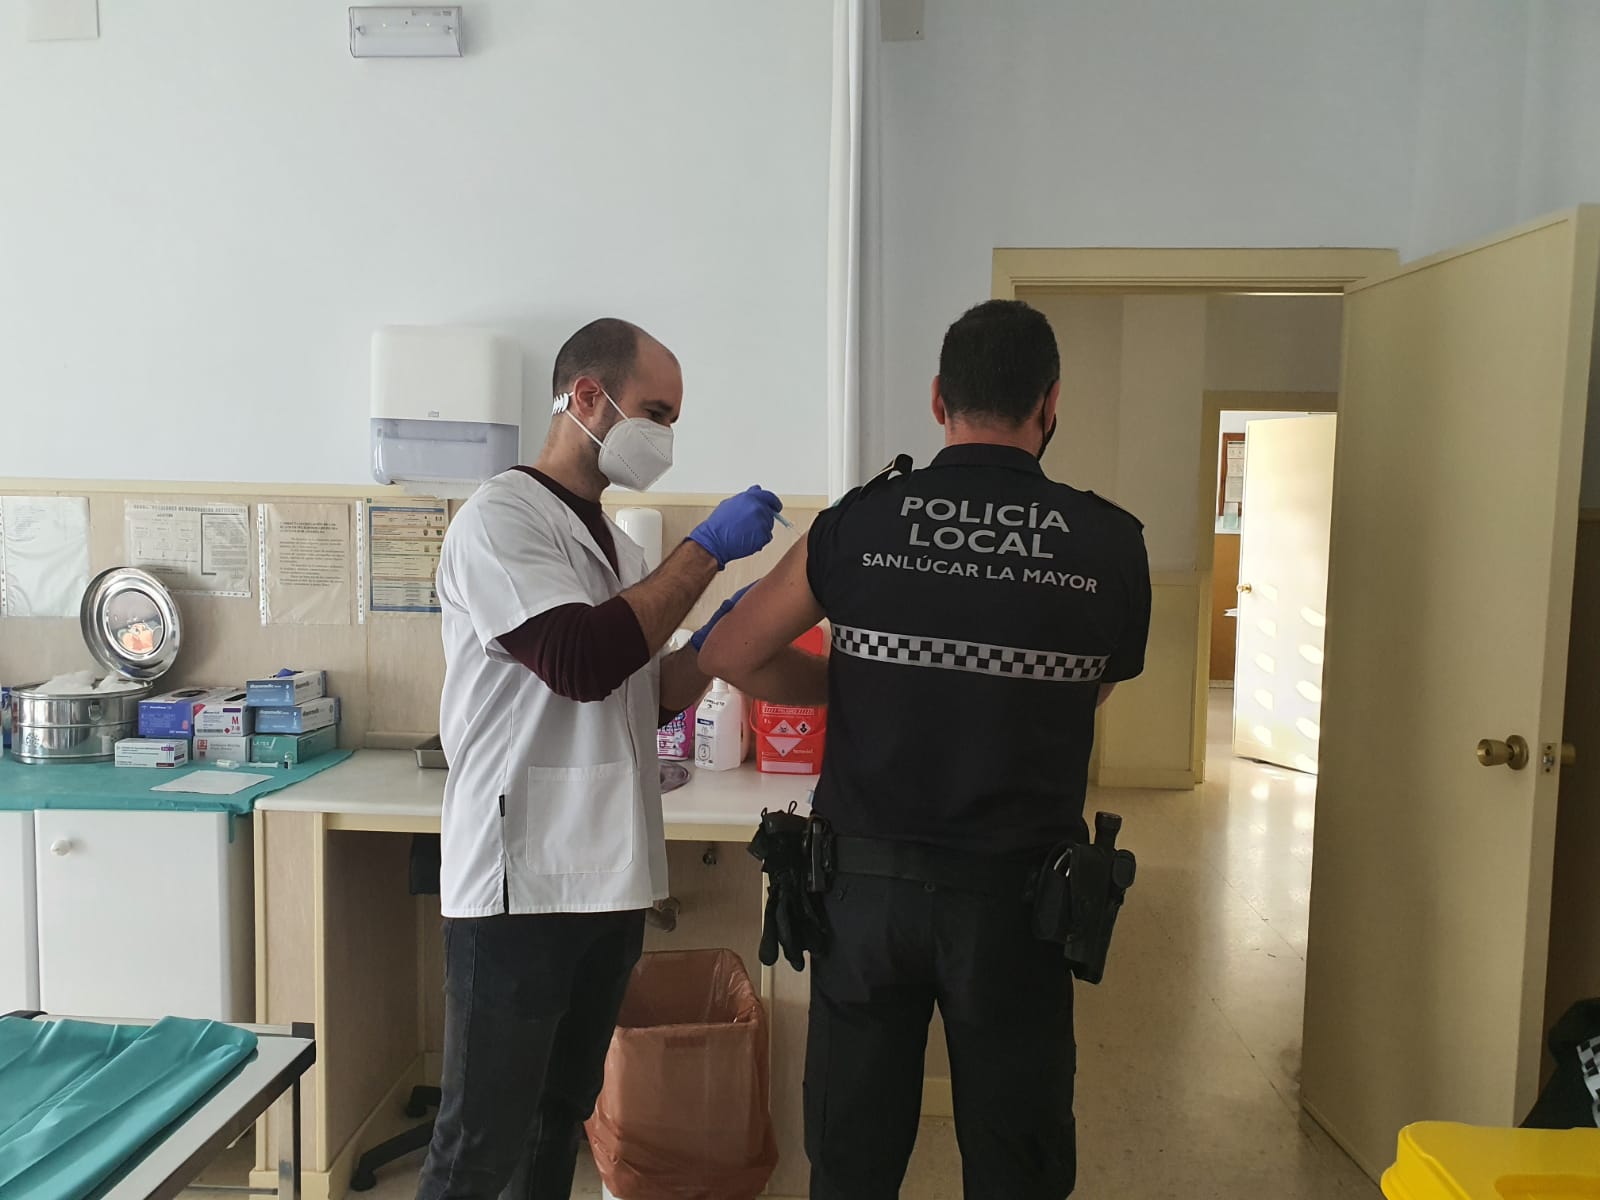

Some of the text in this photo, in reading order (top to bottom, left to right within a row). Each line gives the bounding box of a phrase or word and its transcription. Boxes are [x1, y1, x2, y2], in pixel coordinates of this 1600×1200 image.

[900, 496, 1071, 532] POLICÍA
[909, 523, 1054, 559] LOCAL
[862, 553, 1097, 593] SANLÚCAR LA MAYOR
[231, 716, 239, 725] M
